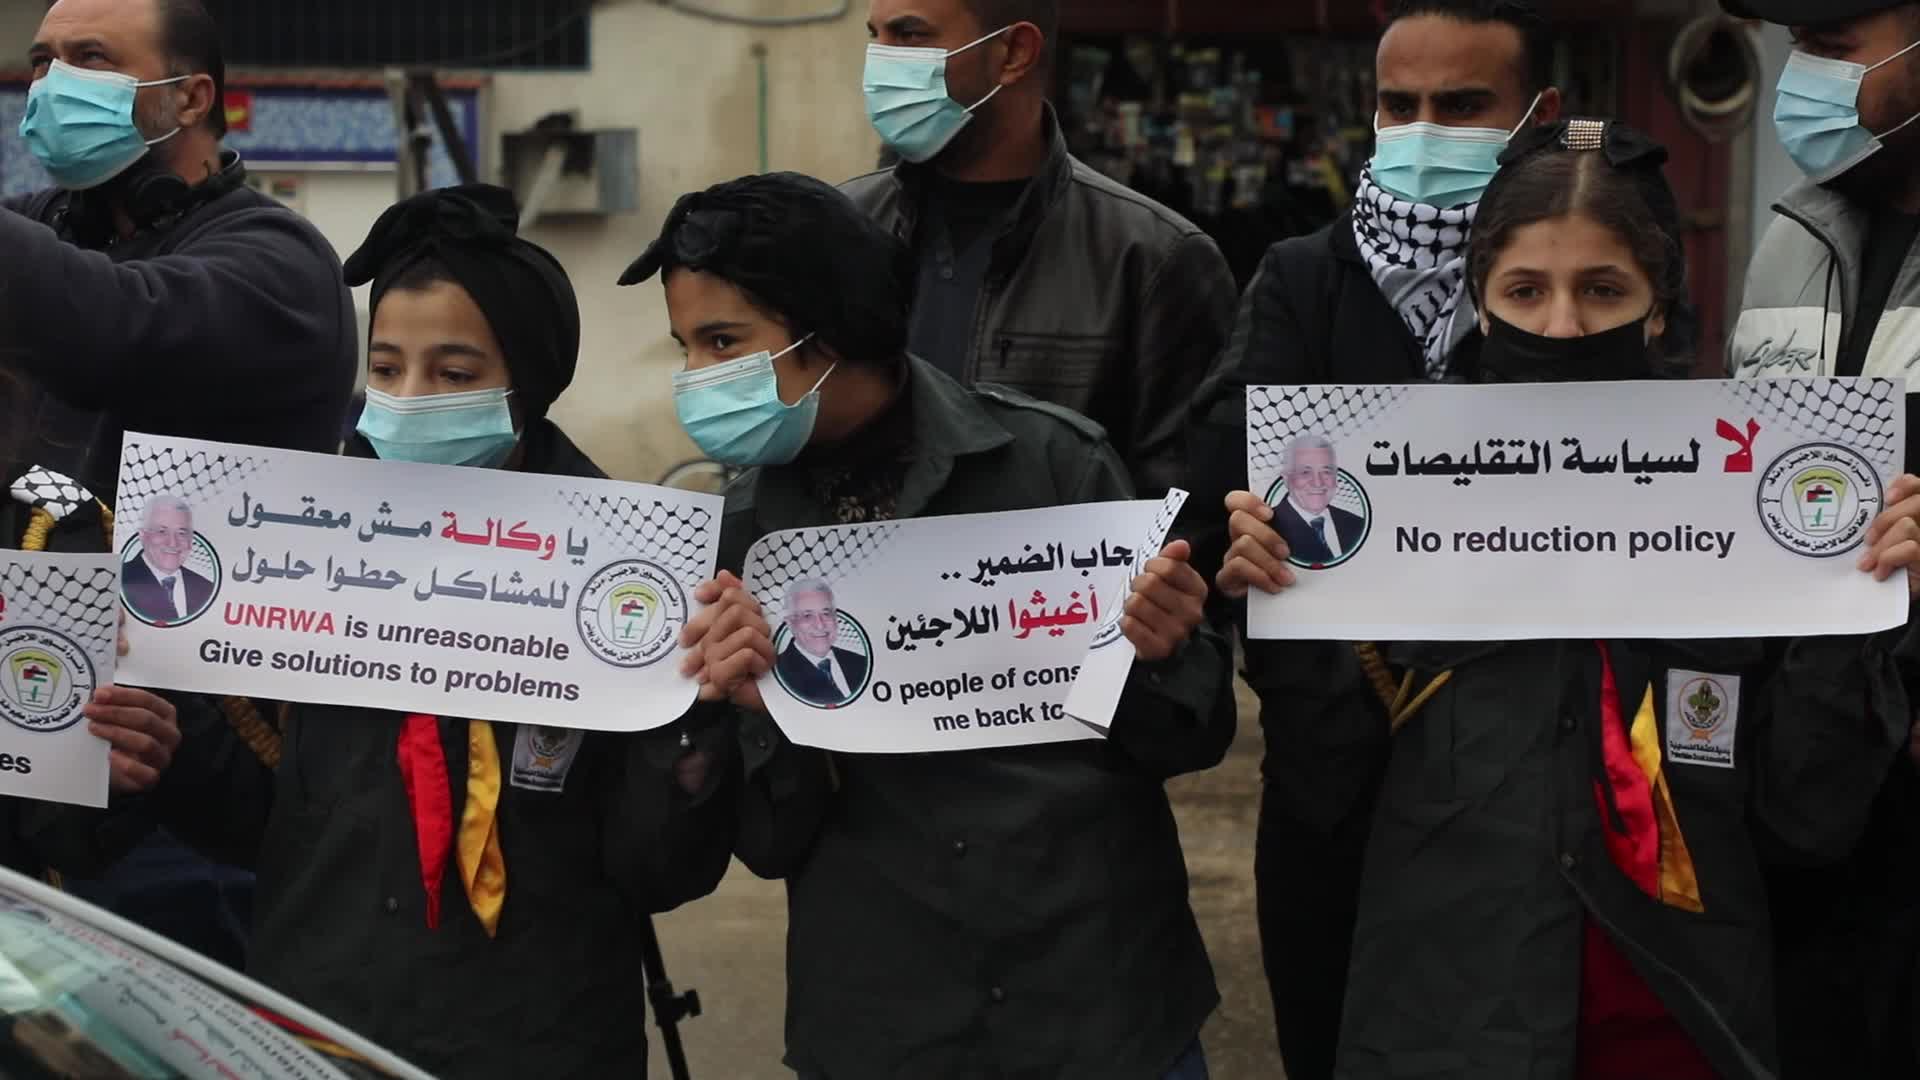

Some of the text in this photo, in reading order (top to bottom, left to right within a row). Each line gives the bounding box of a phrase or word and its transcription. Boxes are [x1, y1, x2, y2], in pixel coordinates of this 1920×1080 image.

[1365, 417, 1761, 486] لا لسياسة التقليصات
[227, 491, 589, 566] يا وكالة مش معقول
[1396, 525, 1736, 558] No reduction policy
[231, 546, 571, 609] للمشاكل حطوا حلول
[969, 542, 1065, 587] الضمير
[223, 601, 571, 661] UNRWA is unreasonable
[886, 584, 1099, 651] أغيثوا اللاجئين
[199, 638, 580, 702] Give solutions to problems
[872, 681, 892, 702] O
[900, 673, 984, 705] people
[991, 668, 1017, 690] of
[933, 711, 970, 732] me
[976, 703, 1035, 728] back
